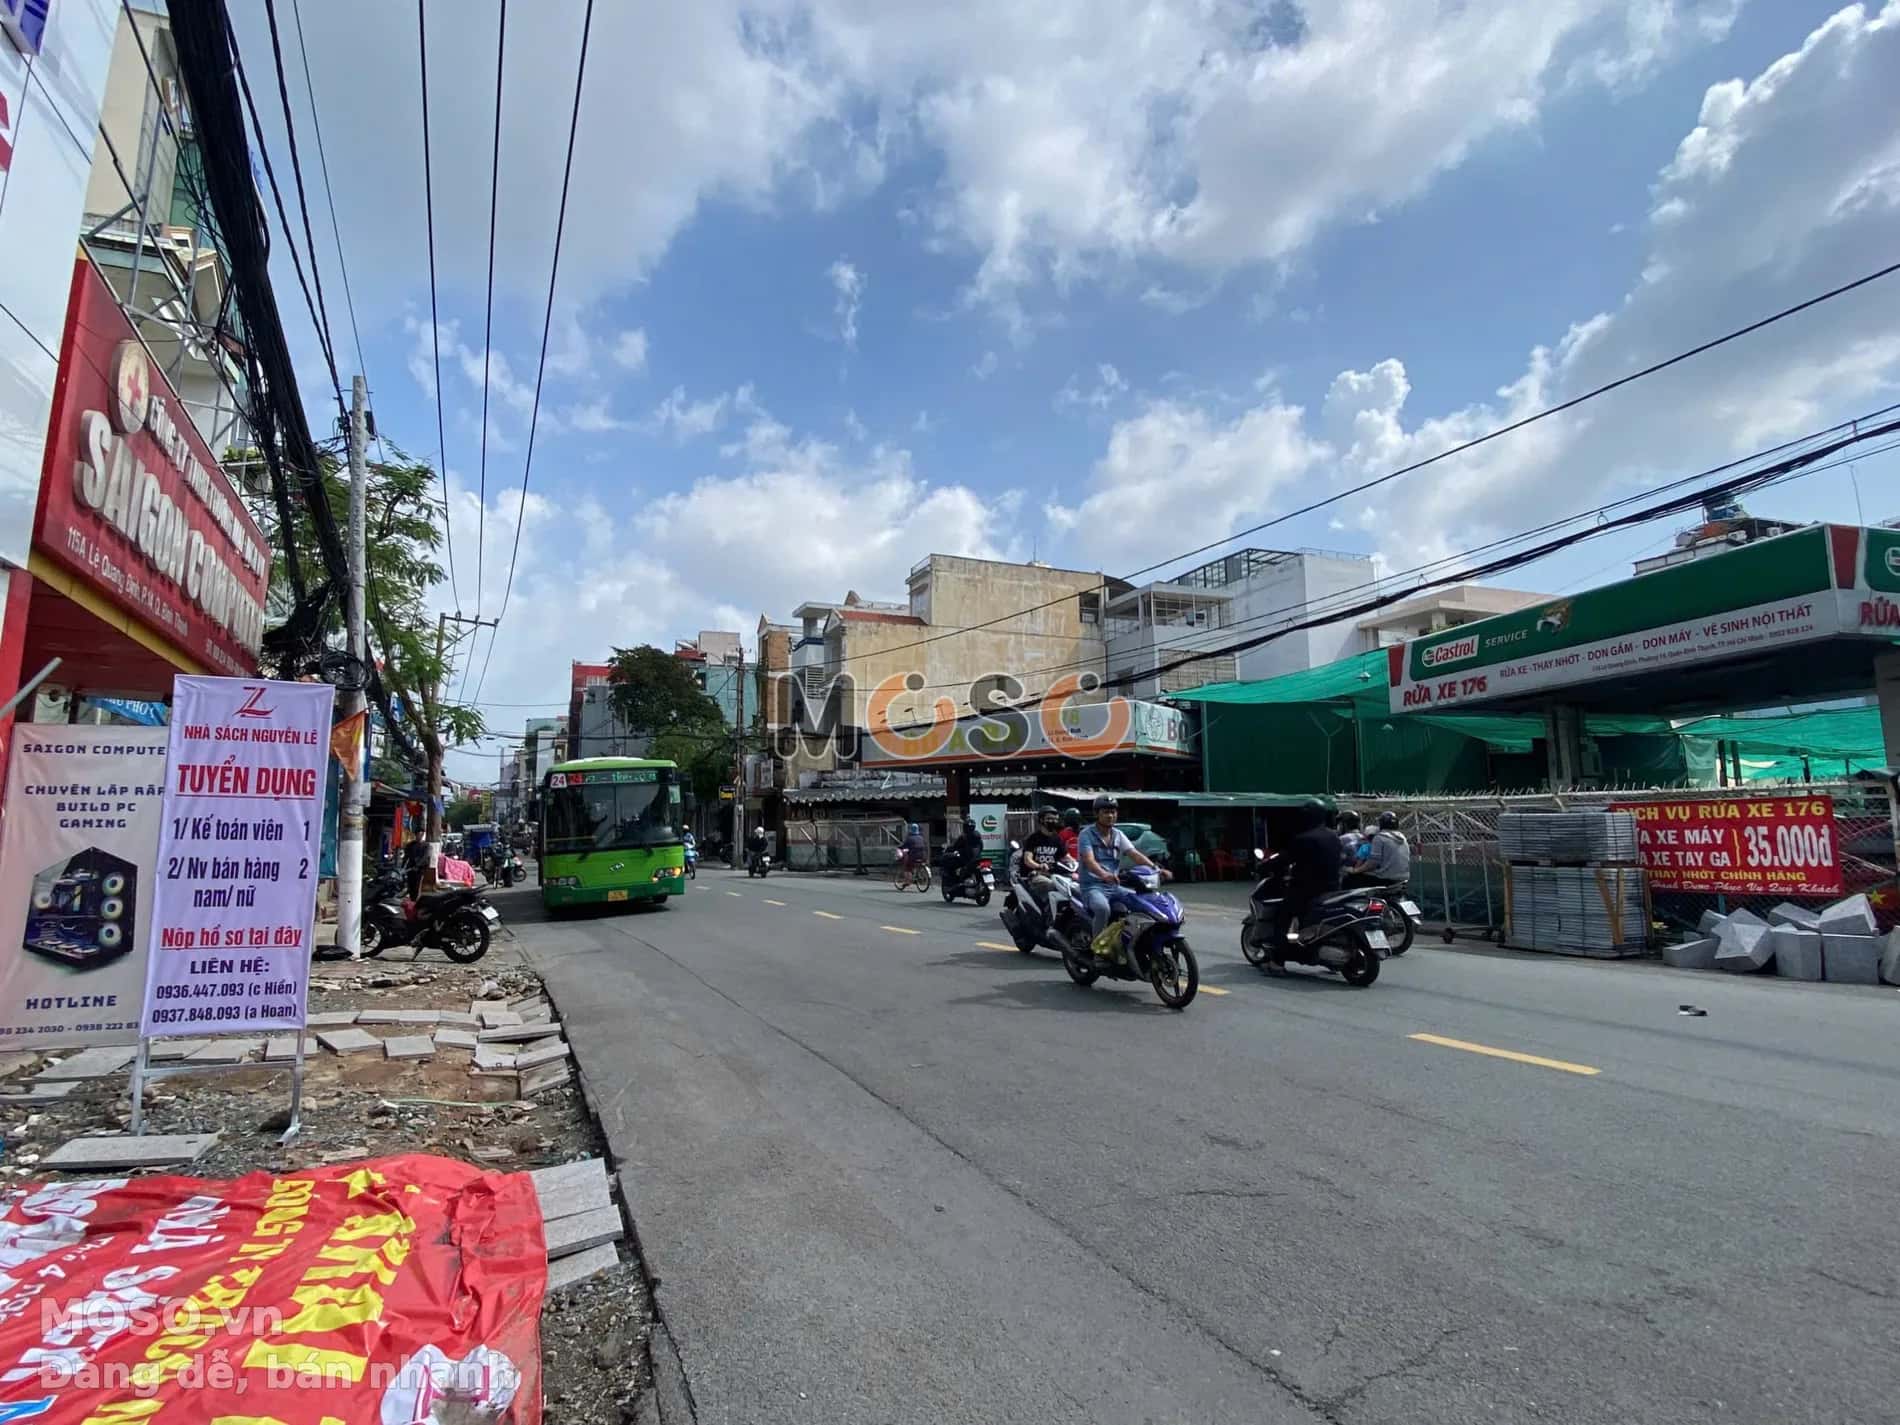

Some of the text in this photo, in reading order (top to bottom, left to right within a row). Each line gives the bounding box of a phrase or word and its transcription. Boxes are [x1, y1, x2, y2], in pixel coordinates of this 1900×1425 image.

[74, 409, 189, 588] SAIGON
[67, 526, 87, 558] 115A
[101, 554, 124, 595] Quang
[1720, 617, 1750, 635] SINH
[1485, 629, 1529, 649] SERVICE
[1433, 639, 1475, 663] Castrol
[1403, 676, 1488, 706] RỬA XE 176
[184, 723, 210, 740] NHÀ
[214, 724, 248, 742] SÁCH
[304, 728, 318, 745] LÊ
[23, 743, 167, 756] SAIGON COMPUTE
[177, 754, 317, 801] TUYỂN DỤNG
[552, 774, 567, 788] 24
[24, 783, 91, 796] CHUYÊN
[56, 802, 137, 813] BUILD PC
[1665, 805, 1691, 823] VỤ
[1699, 801, 1741, 819] RỬA
[1747, 802, 1776, 818] XE
[1784, 800, 1826, 817] 176
[59, 818, 127, 829] GAMING
[173, 813, 310, 841] 1/ Kế toán viên 1
[1656, 829, 1680, 845] XE
[1685, 825, 1725, 845] MÁY
[1743, 824, 1834, 868] 35.000đ
[167, 856, 309, 882] 2/ Nv bán hàng 2
[1652, 851, 1672, 866] XE
[1675, 851, 1704, 867] TAY
[1709, 851, 1732, 867] GA
[193, 884, 257, 908] nam/ nữ
[161, 926, 196, 950] Nộp
[225, 928, 245, 946] sơ
[274, 926, 303, 947] đây
[190, 956, 270, 976] LIÊN HỆ:
[156, 982, 245, 1000] 0936.447.093
[249, 982, 261, 998] (c
[25, 994, 118, 1010] HOTLINE
[152, 1005, 241, 1024] 0937.848.093
[244, 1005, 257, 1021] (a
